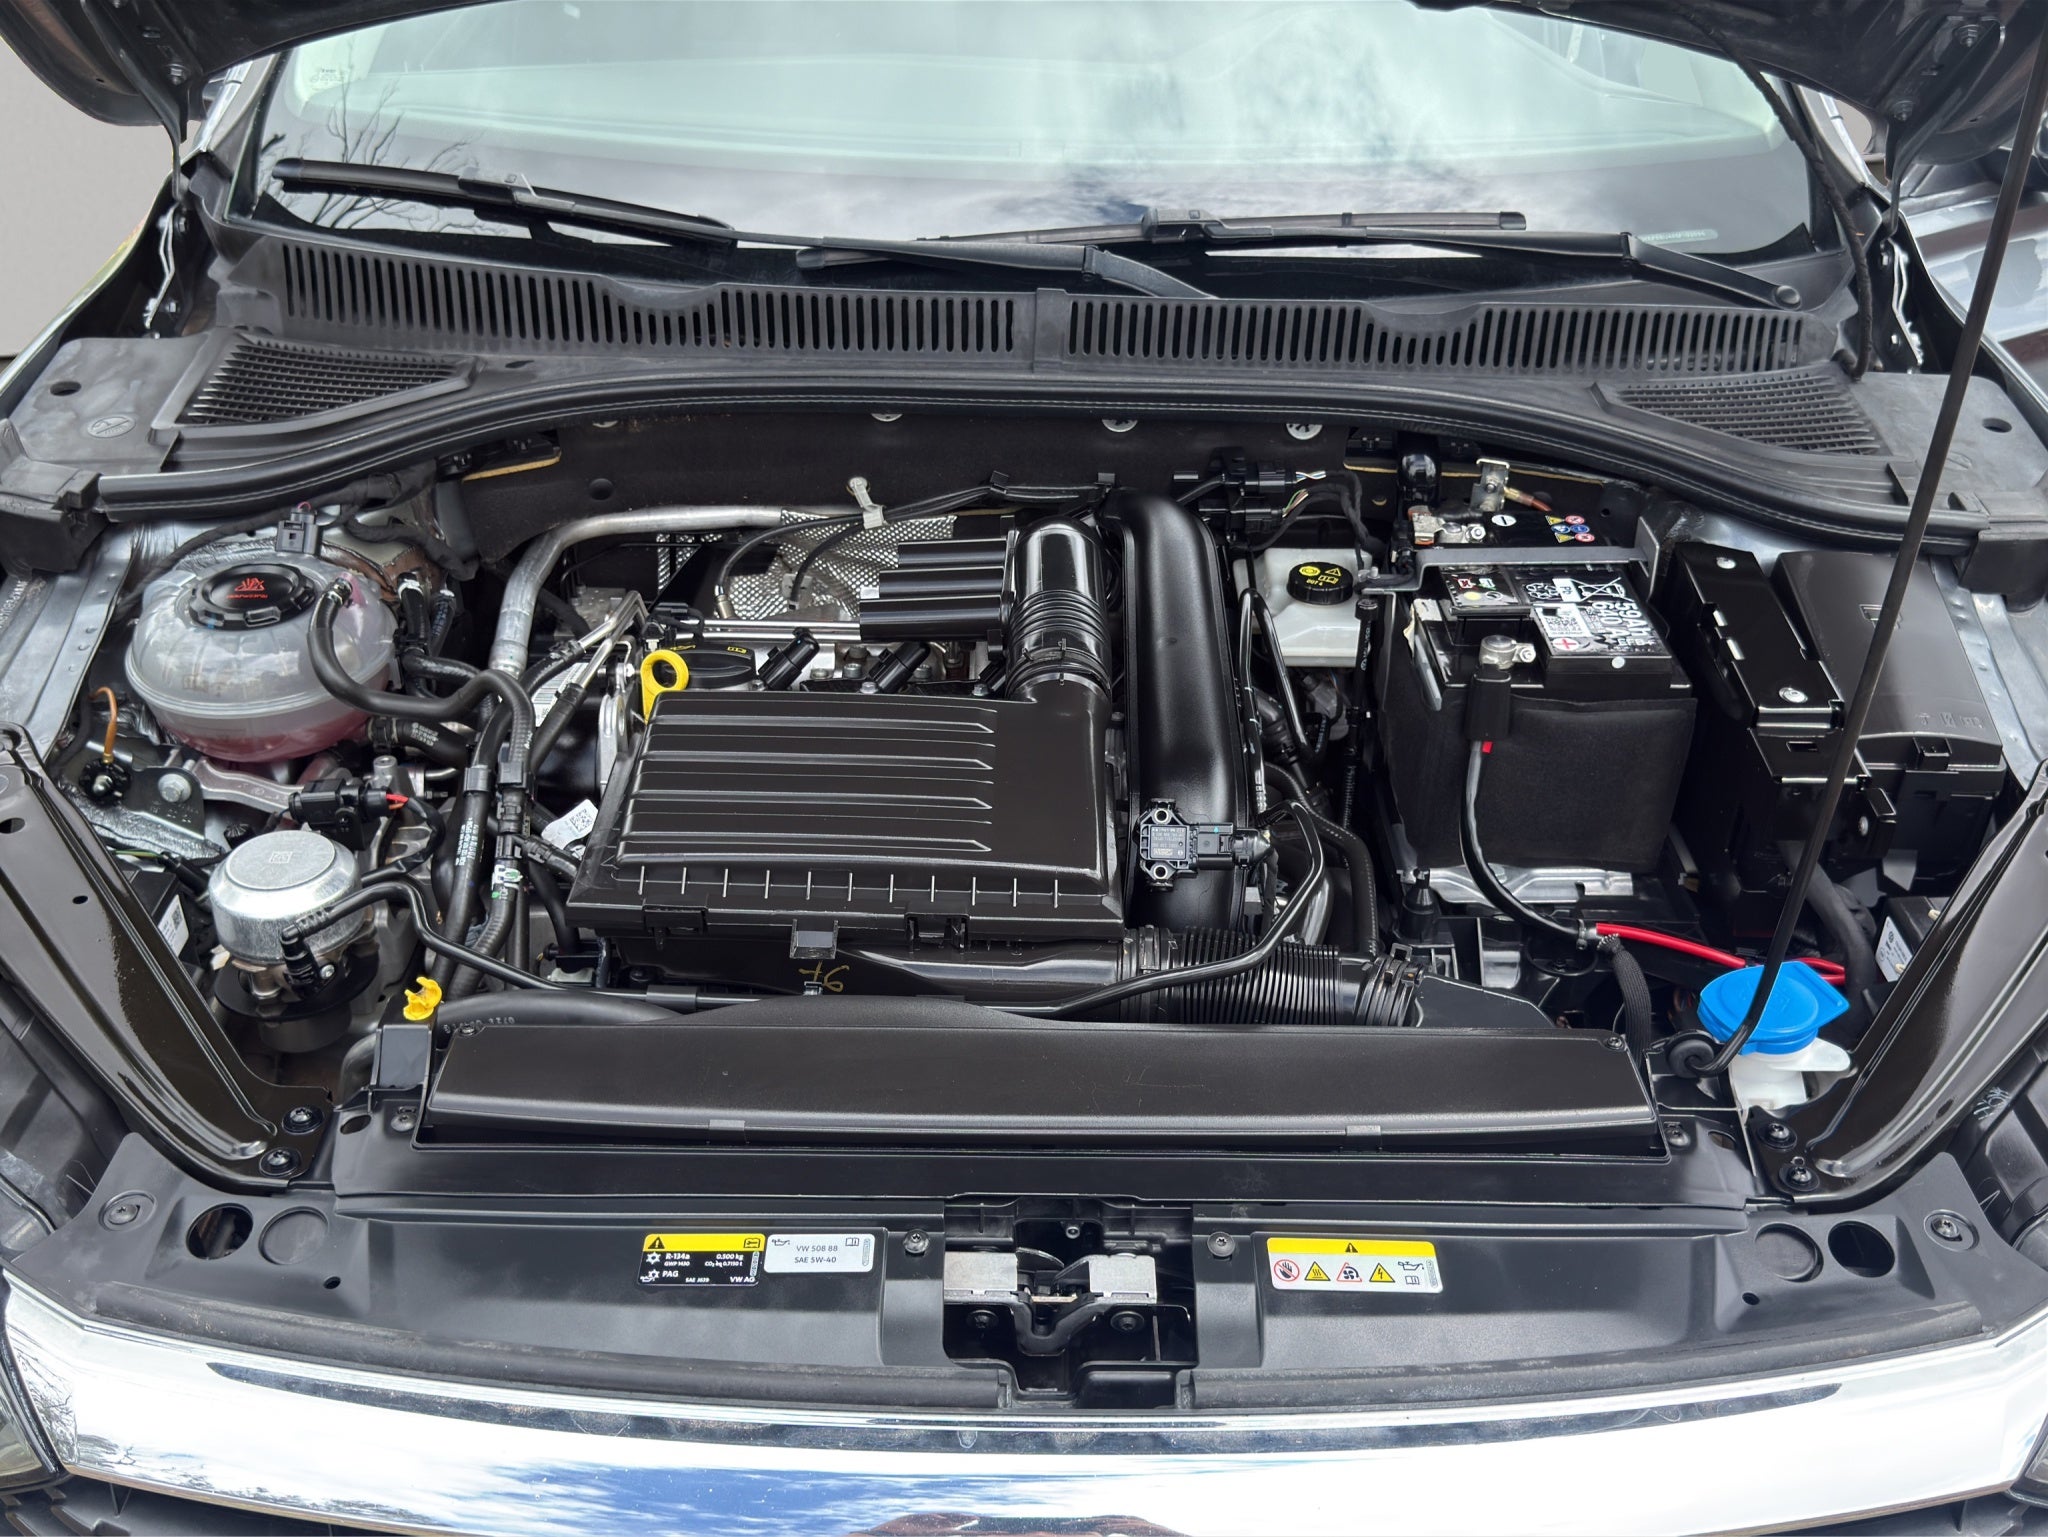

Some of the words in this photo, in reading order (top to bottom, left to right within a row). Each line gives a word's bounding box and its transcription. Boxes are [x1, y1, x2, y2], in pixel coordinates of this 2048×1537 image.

[1591, 601, 1623, 625] 640
[1615, 602, 1652, 636] 59Ah
[665, 1252, 690, 1260] R-134a
[735, 1253, 744, 1261] kg
[662, 1270, 679, 1278] PAG
